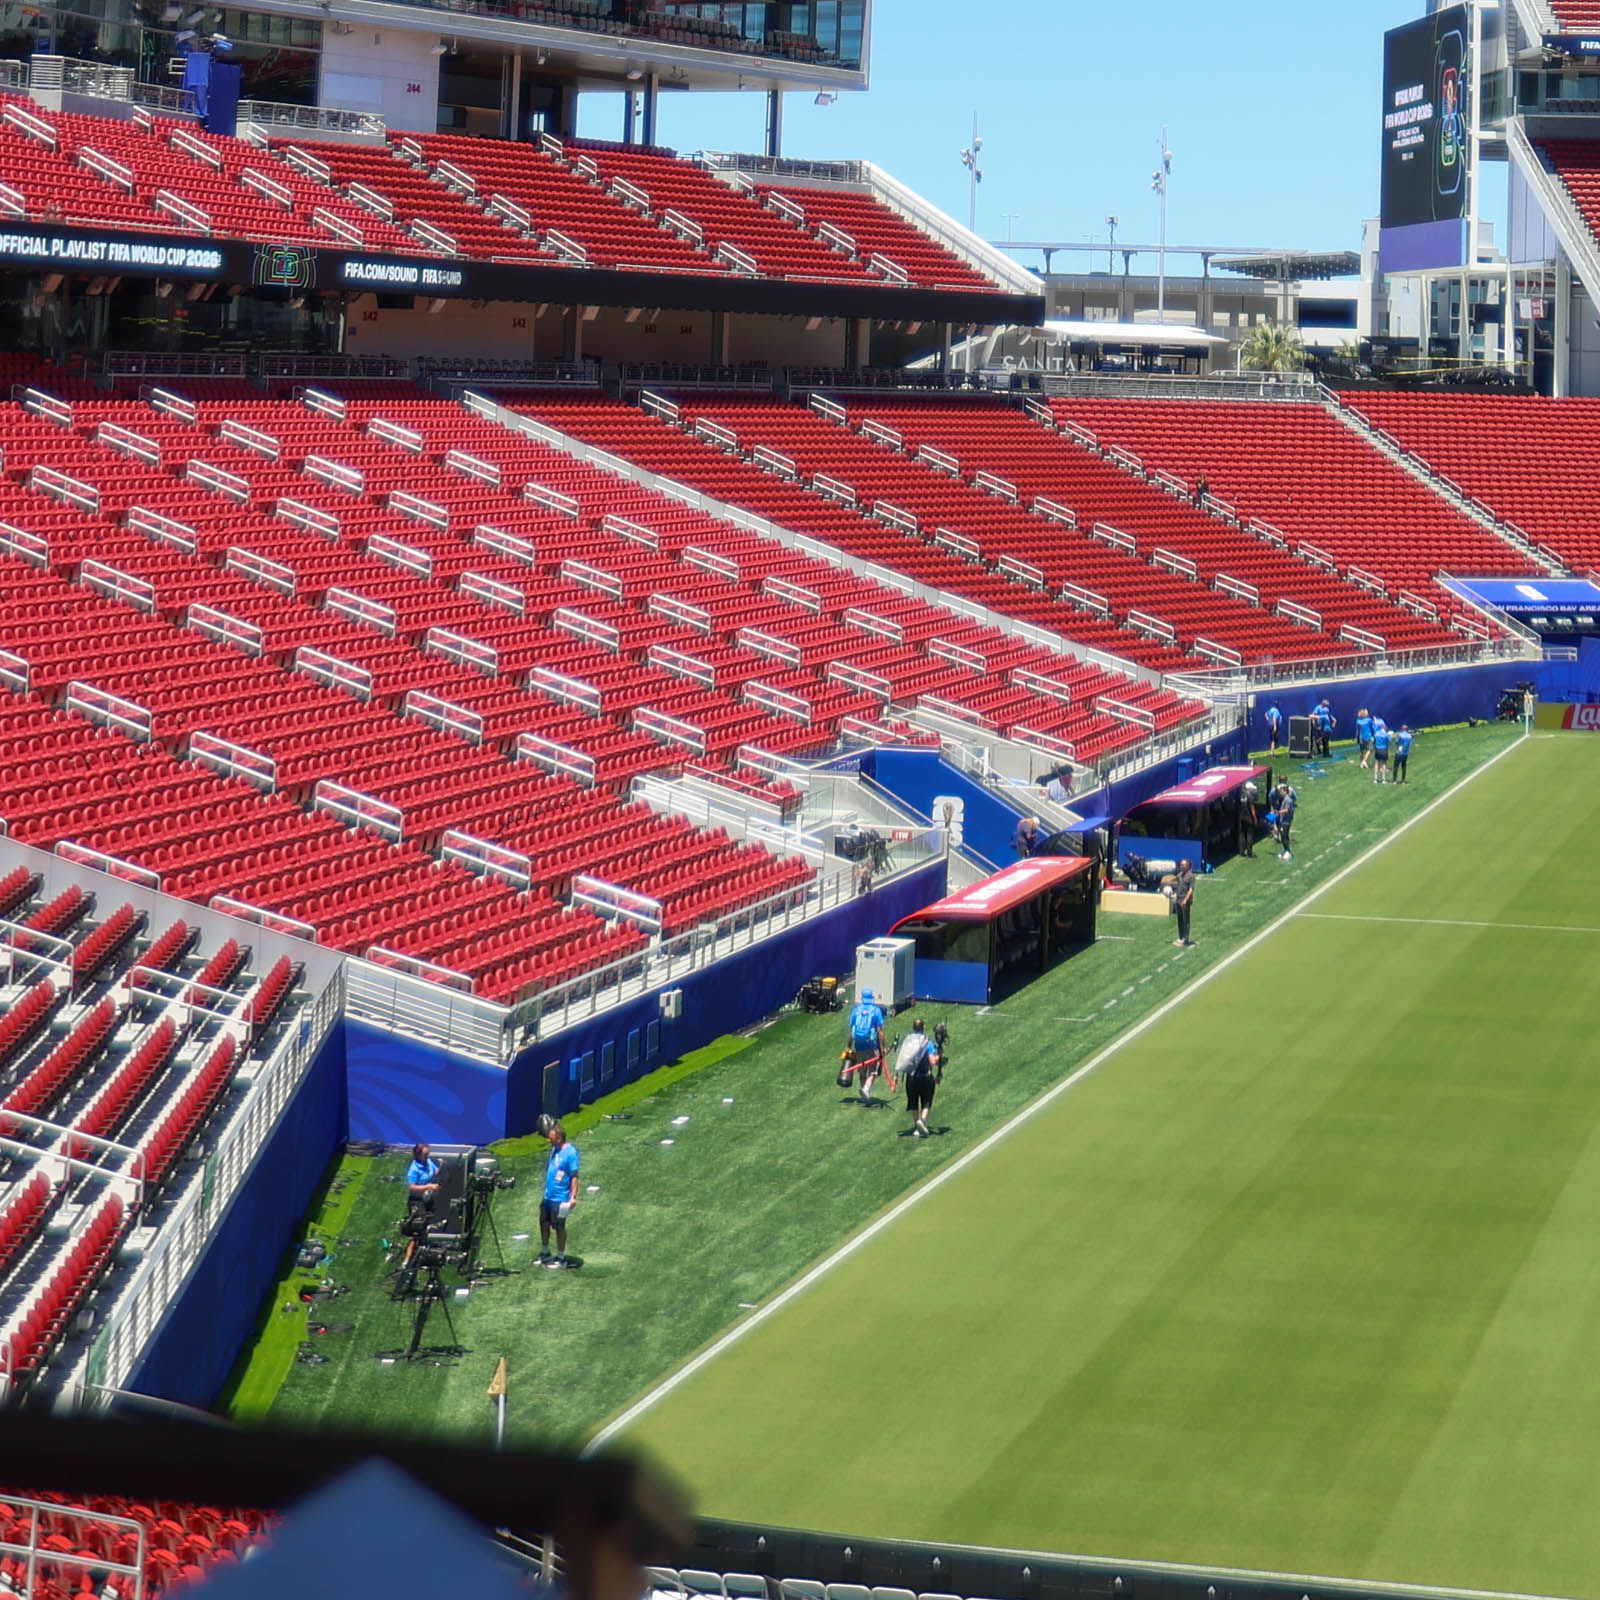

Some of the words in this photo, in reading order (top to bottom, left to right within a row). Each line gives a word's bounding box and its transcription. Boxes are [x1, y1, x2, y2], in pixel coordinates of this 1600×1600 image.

[1581, 41, 1600, 49] FIFA
[407, 83, 420, 93] 244
[52, 238, 107, 260] PLAYLIST
[108, 243, 130, 261] FIFA
[131, 245, 165, 264] WORLD
[167, 248, 185, 266] CUP
[345, 262, 418, 283] FIFA.COM/SOUND
[422, 268, 437, 284] FIFA
[363, 311, 377, 321] 142
[513, 318, 526, 328] 142
